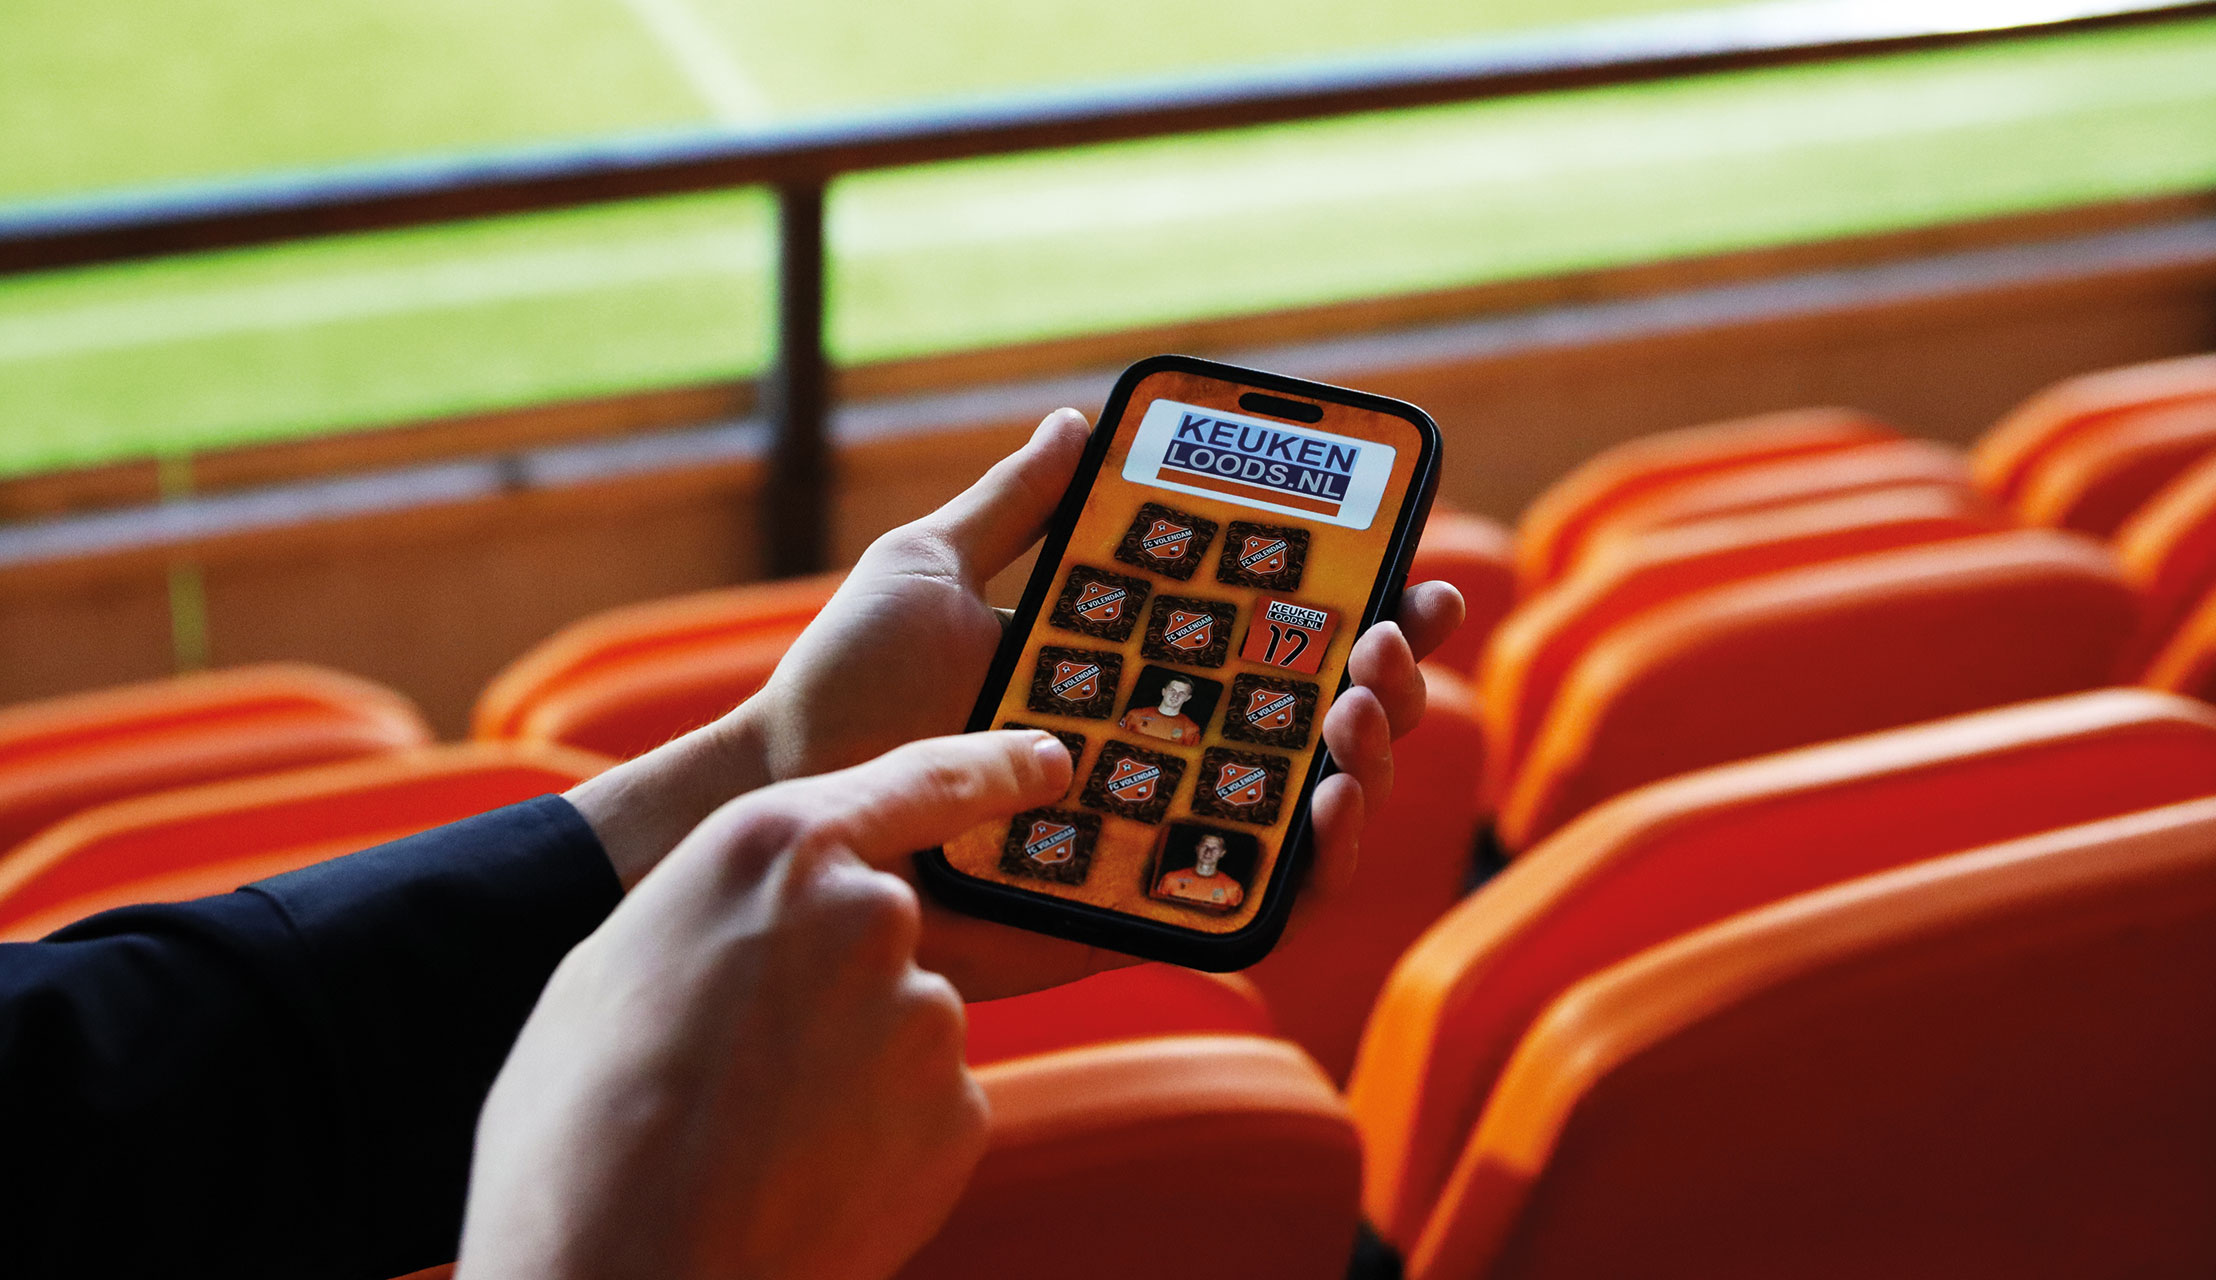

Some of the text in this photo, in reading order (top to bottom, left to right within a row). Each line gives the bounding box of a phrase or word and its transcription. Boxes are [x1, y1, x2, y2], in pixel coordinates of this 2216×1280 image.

[1177, 415, 1358, 473] KEUKEN
[1167, 443, 1341, 498] LOODS.NL
[1143, 529, 1193, 550] FC VOLENDAM
[1241, 541, 1287, 567] FC VOLENDAM
[1077, 589, 1126, 613] FC VOLENDAM
[1271, 603, 1325, 622] KEUKEN
[1166, 615, 1212, 643] FC VOLENDAM
[1268, 611, 1320, 630] LOODS.NL
[1053, 666, 1100, 694] FC VOLENDAM
[1248, 695, 1295, 722] FC VOLENDAM
[1109, 768, 1160, 791] FC VOLENDAM
[1217, 769, 1266, 797] FC VOLENDAM
[1027, 827, 1076, 855] FC VOLENDAM
